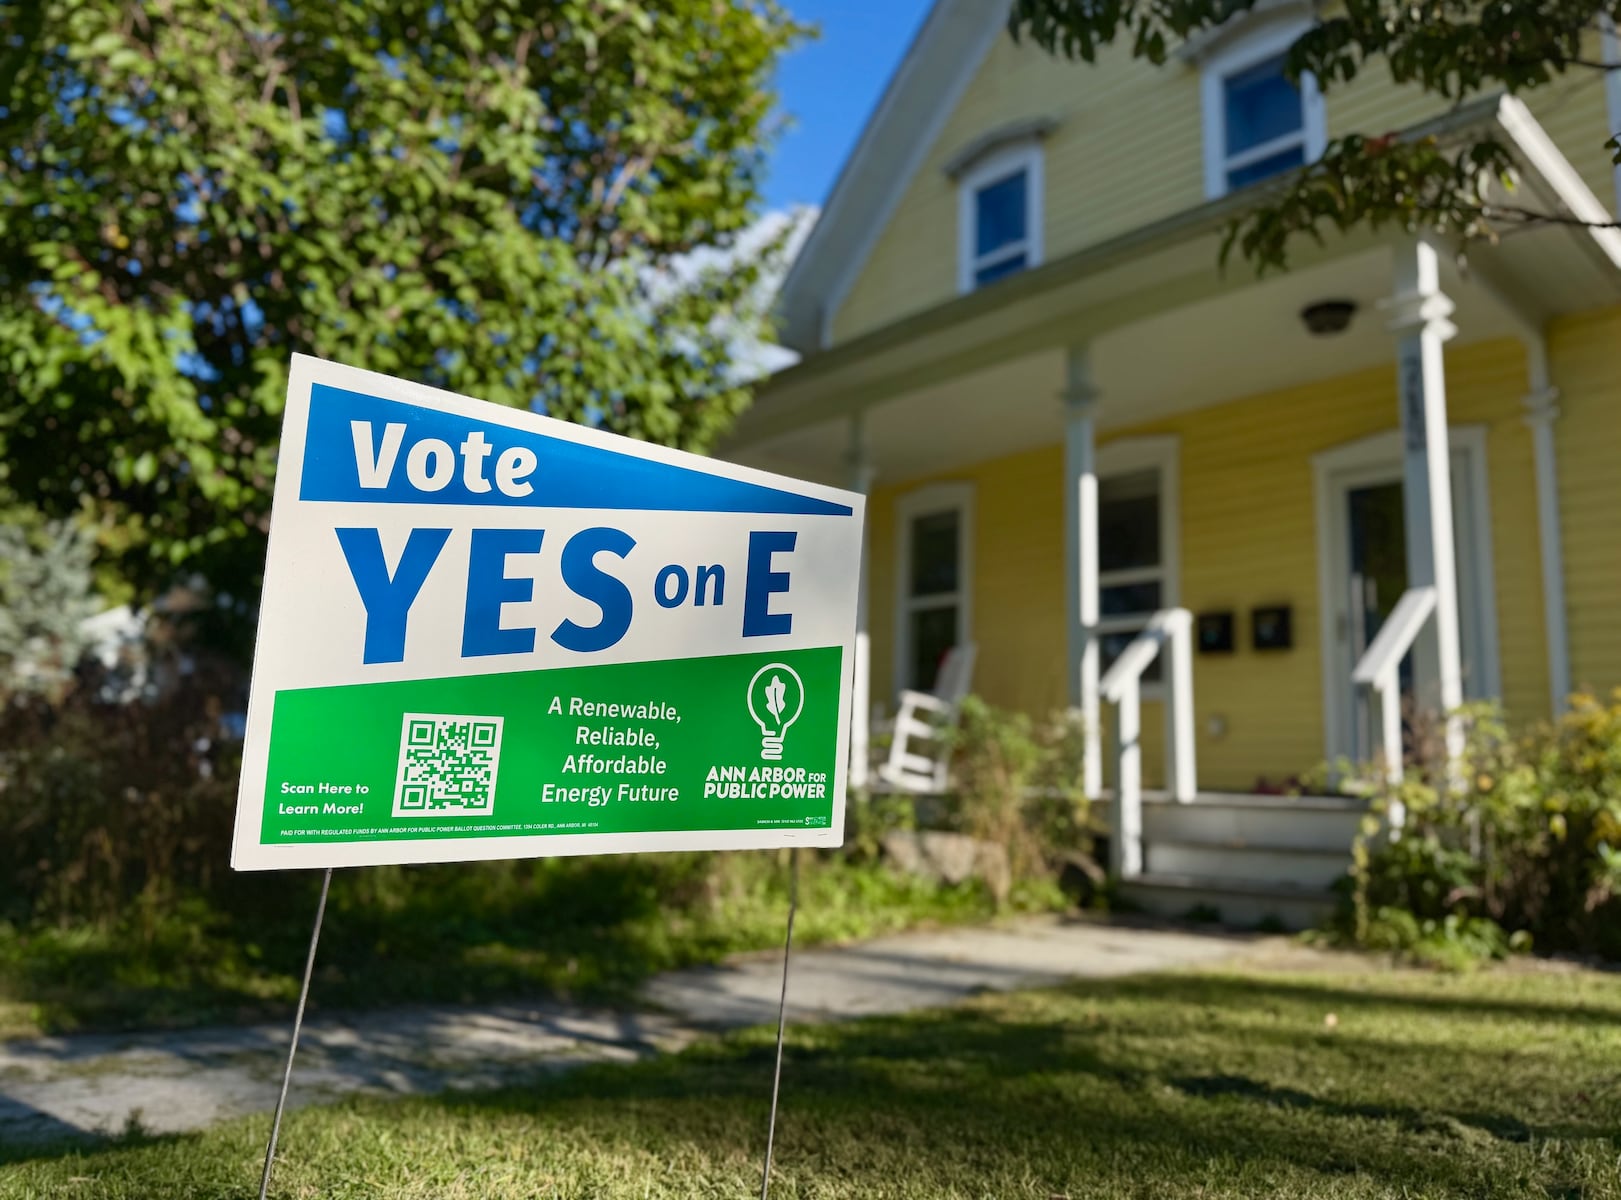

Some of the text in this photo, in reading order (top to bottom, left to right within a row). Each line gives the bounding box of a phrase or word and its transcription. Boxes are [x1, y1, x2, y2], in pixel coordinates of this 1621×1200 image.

[350, 420, 538, 498] Vote
[335, 526, 797, 664] YES on E
[547, 696, 682, 724] A Renewable,
[575, 726, 661, 751] Reliable,
[562, 755, 667, 776] Affordable
[705, 766, 826, 783] ANN ARBOR FOR
[281, 782, 369, 794] Scan Here to
[541, 784, 679, 807] Energy Future
[703, 783, 825, 799] PUBLIC POWER
[279, 803, 363, 815] Learn More!
